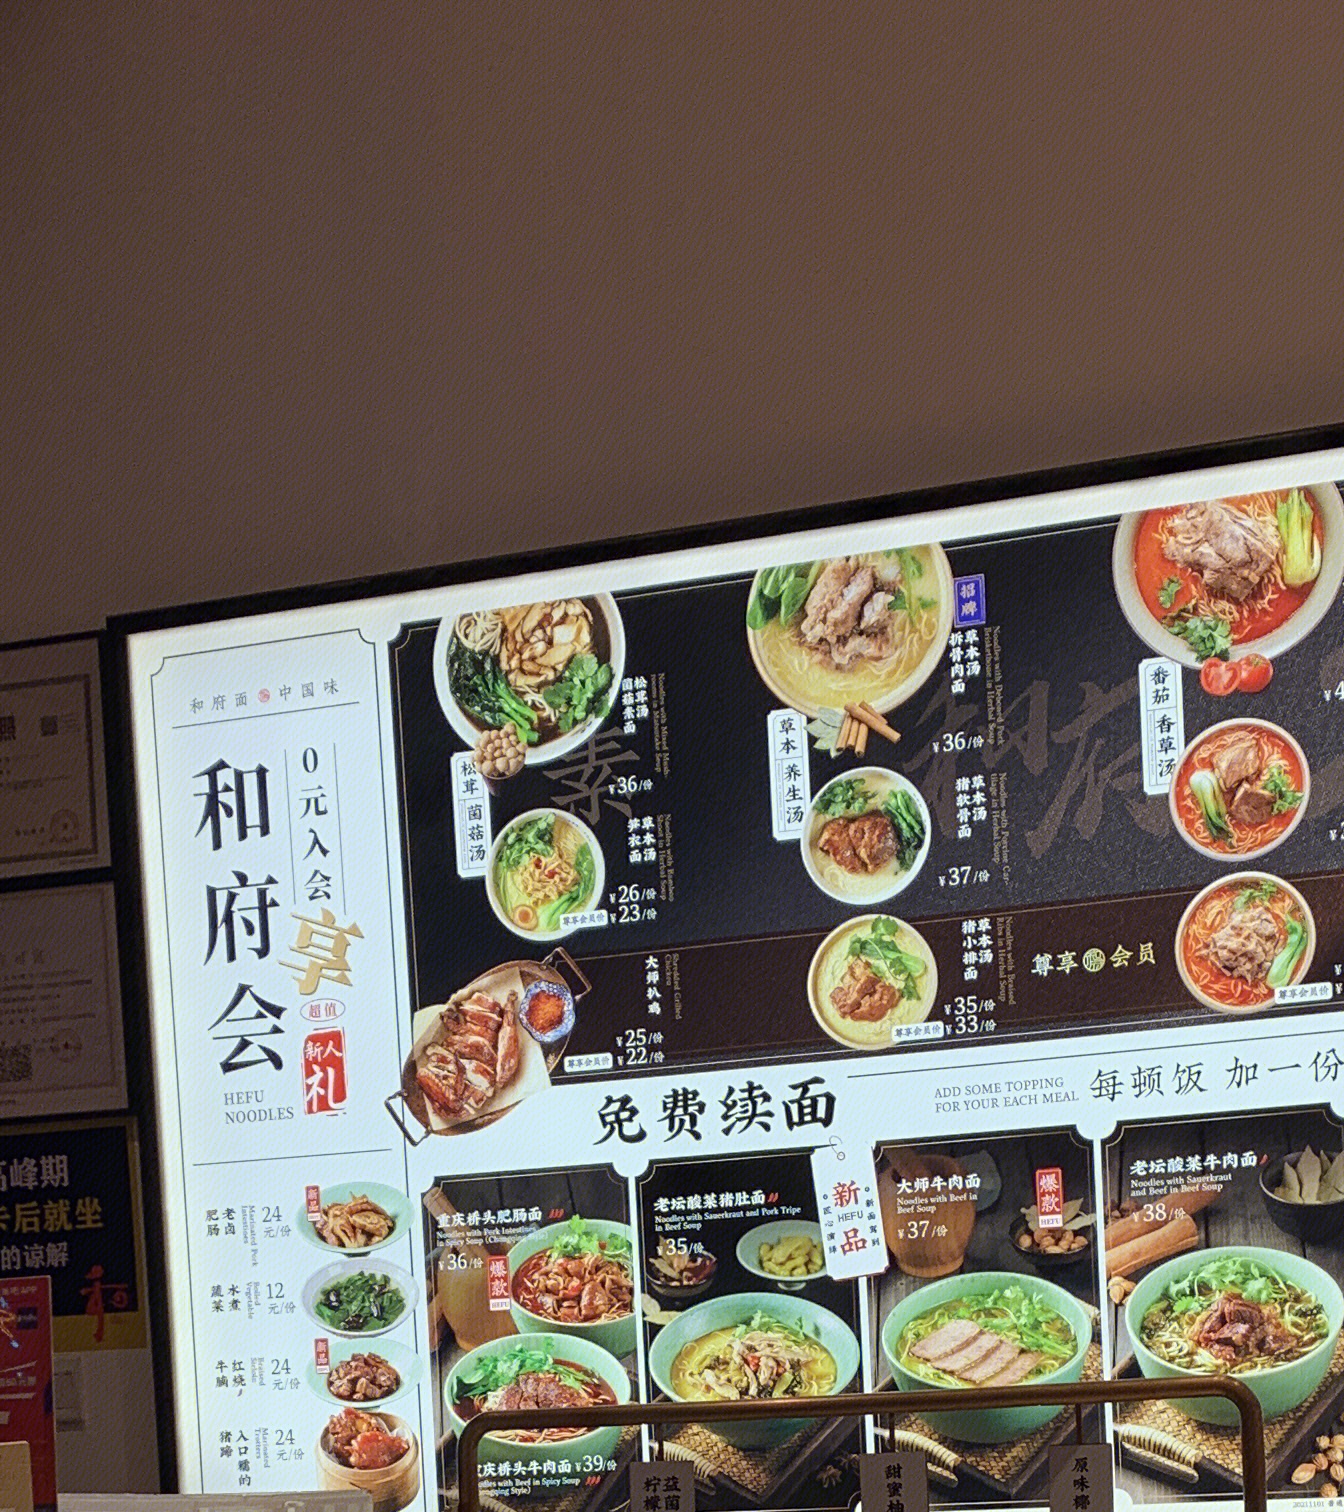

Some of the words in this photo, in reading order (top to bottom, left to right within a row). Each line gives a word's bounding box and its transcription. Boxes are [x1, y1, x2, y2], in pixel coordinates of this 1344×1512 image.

[959, 582, 979, 618] 招牌
[949, 631, 966, 696] 拆骨肉面
[964, 628, 981, 677] 草本汤
[190, 692, 248, 714] 和府面
[278, 678, 339, 701] 中国味
[634, 676, 649, 718] 松茸汤
[1150, 665, 1172, 706] 番茄
[621, 677, 637, 735] 菌菇素面
[778, 717, 798, 756] 草本
[932, 730, 985, 755] ¥36/份
[1155, 714, 1177, 778] 香草汤
[608, 774, 654, 795] ¥36/份
[784, 763, 806, 825] 养生汤
[955, 776, 973, 839] 猪软骨面
[970, 774, 987, 822] 草本汤
[299, 747, 333, 901] 0元入会
[467, 803, 487, 863] 菌菇汤
[641, 816, 657, 863] 草本汤
[938, 866, 991, 887] ¥37/份
[609, 883, 658, 905] ¥26/份
[192, 758, 287, 1075] 和府会
[561, 911, 607, 927] 尊享会员价
[610, 904, 658, 924] ¥23/份
[961, 919, 979, 981] 猪小排面
[977, 917, 994, 965] 草本汤
[645, 954, 663, 1017] 大师扒鸡
[1278, 986, 1330, 1000] 尊享会员价
[308, 1003, 338, 1019] 超值
[944, 995, 997, 1016] ¥35/份
[894, 1023, 942, 1039] 尊享会员价
[945, 1015, 998, 1036] ¥33/份
[616, 1028, 665, 1049] ¥25/份
[305, 1040, 344, 1063] 新人
[617, 1046, 666, 1067] ¥22/份
[934, 1087, 962, 1099] ADD
[964, 1082, 1001, 1096] SOME
[1005, 1076, 1065, 1094] TOPPING
[1089, 1062, 1209, 1102] 每顿饭
[223, 1089, 265, 1106] HEFU
[935, 1101, 961, 1114] FOR
[963, 1096, 1000, 1112] YOUR
[1003, 1094, 1040, 1108] EACH
[1042, 1090, 1079, 1105] MEAL
[225, 1106, 295, 1125] NOODLES
[593, 1076, 837, 1146] 免费续面
[1129, 1150, 1258, 1176] 老坛酸菜牛肉面
[896, 1173, 982, 1195] 大师牛肉面
[1040, 1174, 1062, 1214] 爆款
[653, 1189, 767, 1214] 老坛酸菜猪肚面
[897, 1205, 916, 1215] Beef
[916, 1204, 937, 1215] Soup
[1132, 1202, 1186, 1223] ¥38/份
[261, 1206, 283, 1223] 24
[436, 1206, 543, 1229] 重庆桥头肥肠面
[837, 1211, 865, 1223] HEFU
[263, 1225, 293, 1238] 元/份
[897, 1220, 948, 1240] ¥37/份
[656, 1237, 705, 1257] ¥35/份
[438, 1253, 485, 1271] ¥36/份
[490, 1260, 509, 1297] 爆款
[266, 1282, 285, 1299] 12
[267, 1302, 297, 1315] 元/份
[270, 1358, 292, 1375] 24
[272, 1378, 301, 1391] 元/份
[274, 1429, 296, 1446] 24
[236, 1430, 252, 1487] 入口糯的
[276, 1448, 305, 1462] 元/份
[575, 1454, 618, 1474] ¥39/份
[477, 1457, 573, 1477] 庆桥头牛肉面
[643, 1475, 662, 1512] 柠檬
